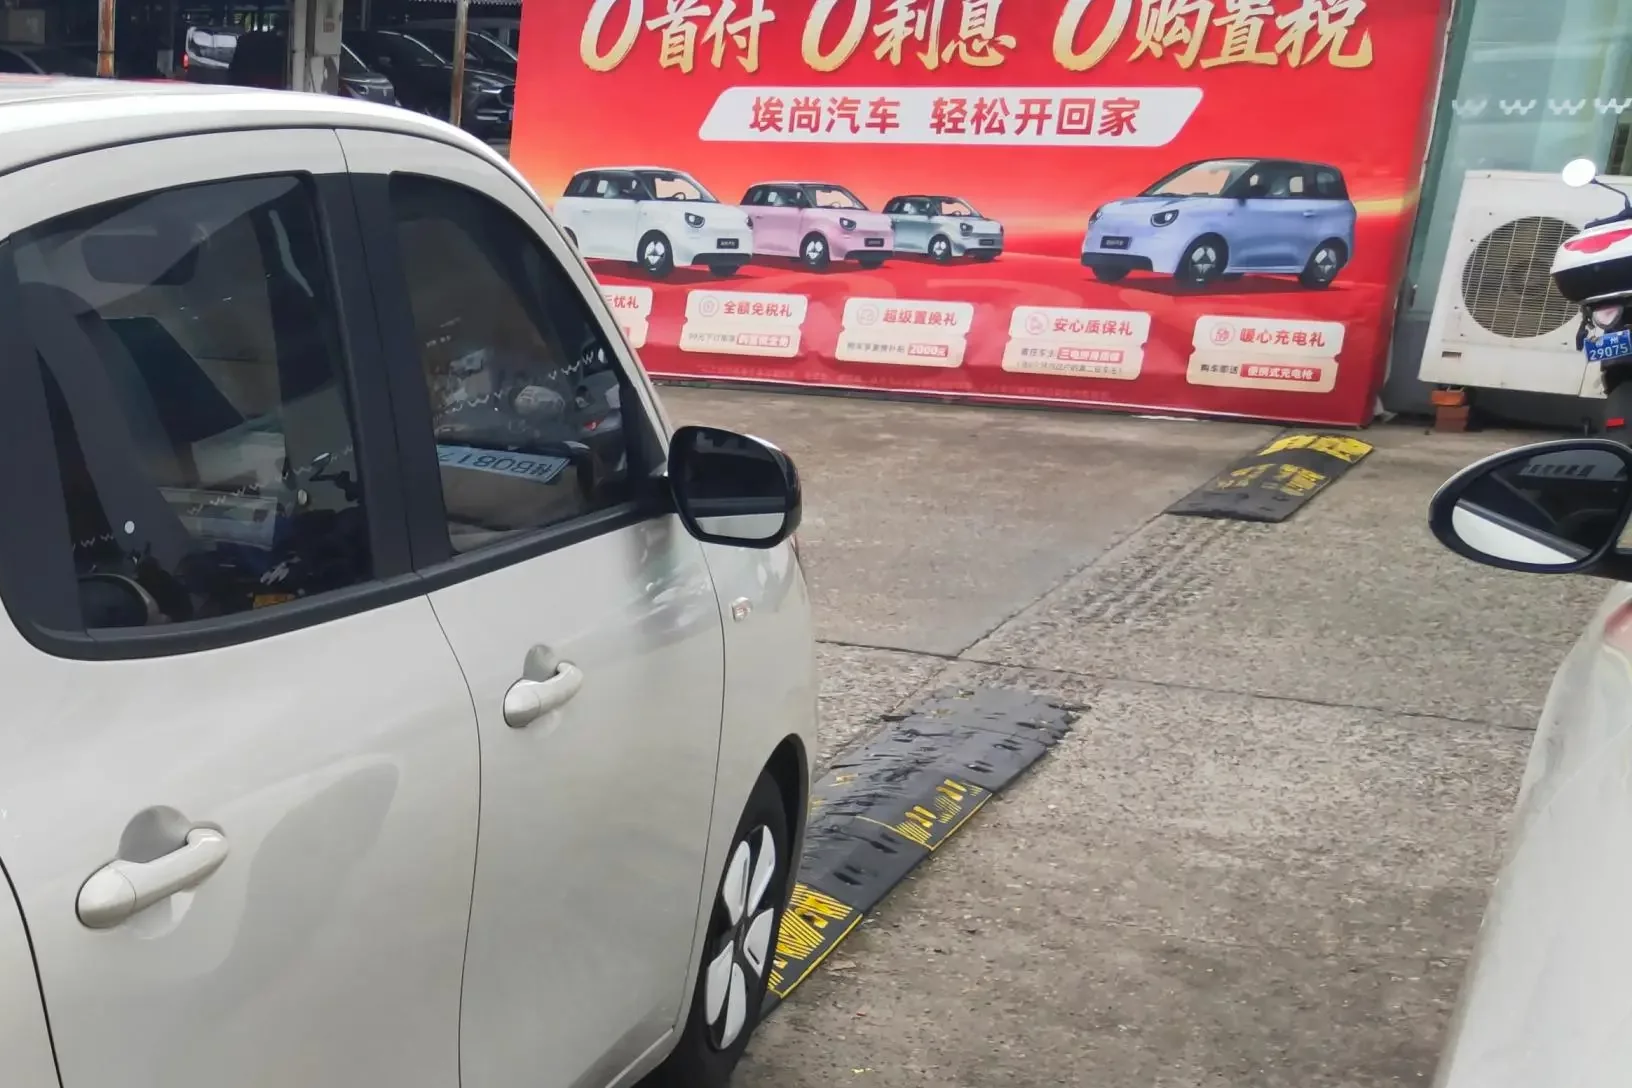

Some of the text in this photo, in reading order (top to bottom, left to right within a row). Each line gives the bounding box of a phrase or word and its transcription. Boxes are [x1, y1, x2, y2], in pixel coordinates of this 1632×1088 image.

[748, 96, 1142, 137] 埃尚汽车 轻松开回家
[723, 300, 793, 318] 全额免税礼
[883, 308, 958, 326] 超级置换礼
[1053, 318, 1134, 336] 安心质保礼
[1239, 328, 1326, 347] 暖心充电礼
[1589, 343, 1629, 360] 29075
